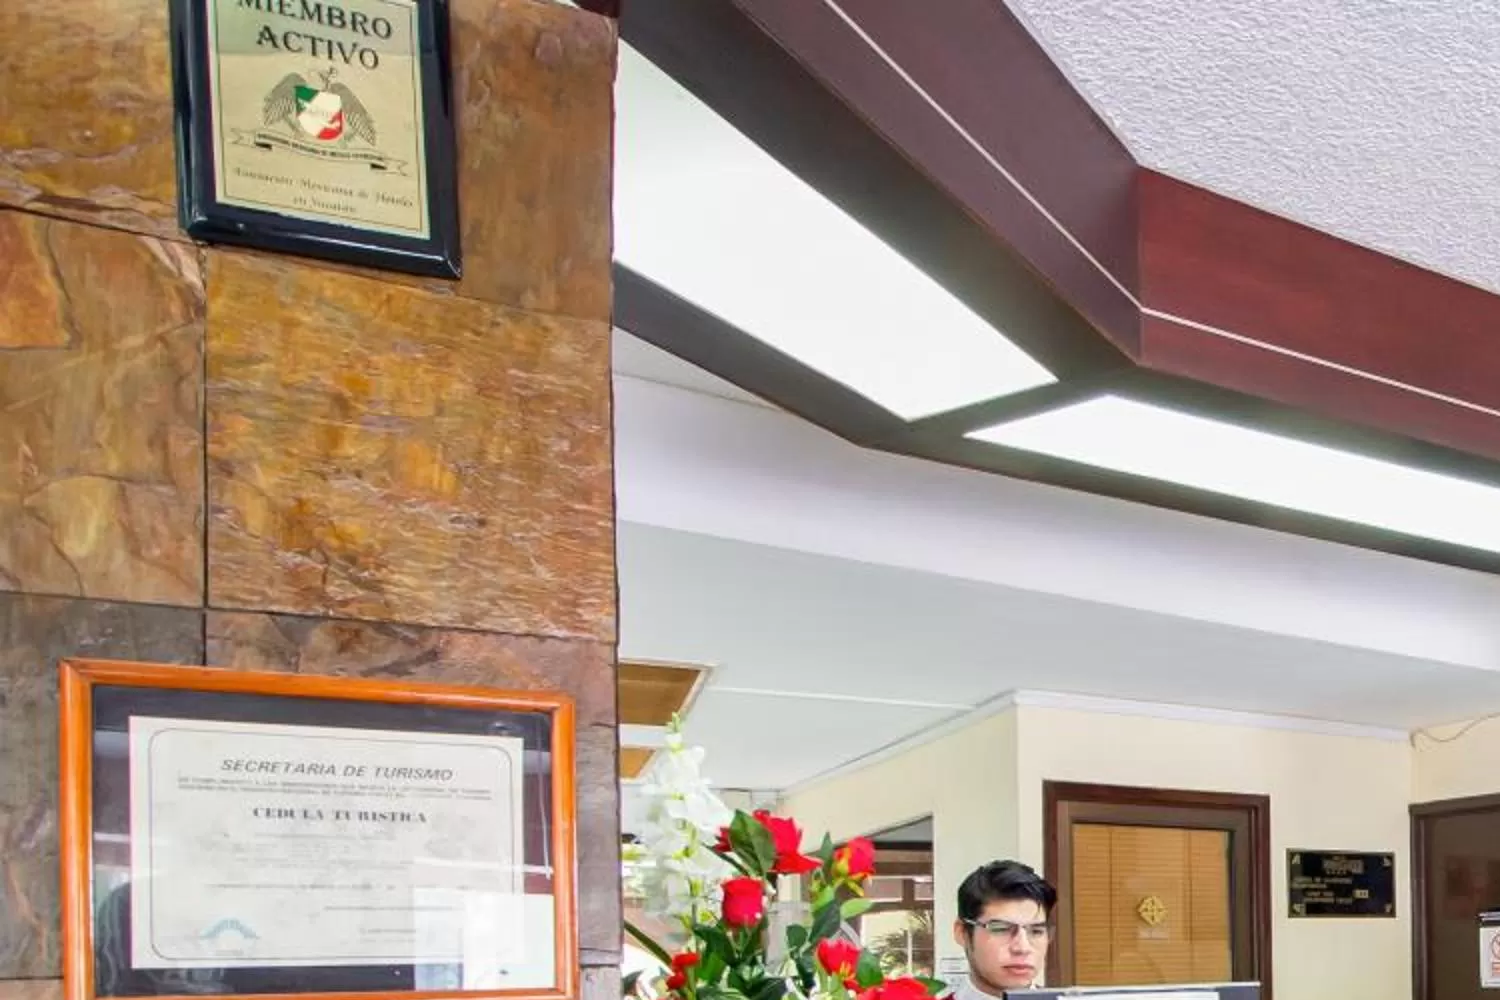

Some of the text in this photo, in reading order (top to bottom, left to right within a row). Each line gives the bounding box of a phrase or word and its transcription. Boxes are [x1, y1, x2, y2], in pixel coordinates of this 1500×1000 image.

[256, 24, 380, 70] ACTIVO
[220, 758, 454, 782] SECRETARIA DE TURISMO
[252, 806, 325, 822] CEDULA
